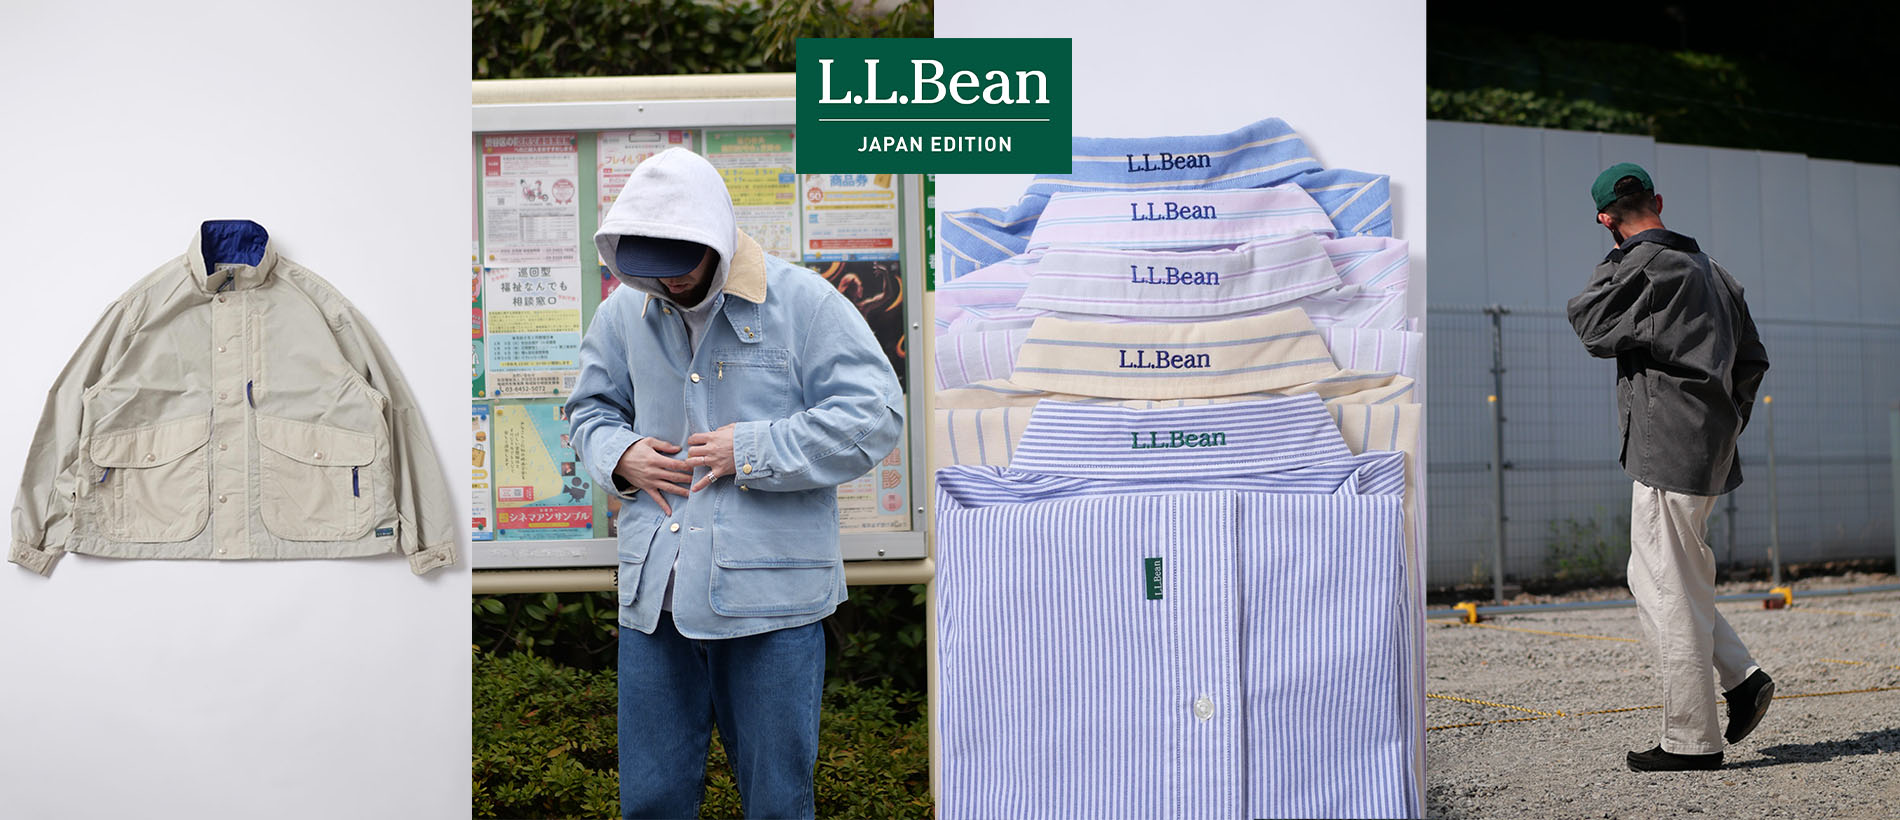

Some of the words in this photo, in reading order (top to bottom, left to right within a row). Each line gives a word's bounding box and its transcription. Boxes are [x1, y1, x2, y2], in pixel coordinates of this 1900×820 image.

[1126, 152, 1212, 173] L.L.Bean
[1130, 201, 1218, 222] L.L.Bean
[518, 266, 551, 278] 巡回型
[1130, 265, 1220, 286] L.L.Bean
[500, 281, 568, 293] 福祉なんでも
[512, 296, 557, 307] 相談窓口
[1119, 349, 1212, 369] L.L.Bean
[1131, 430, 1226, 449] L.L.Bean
[509, 511, 590, 523] シネマアンサンブル
[1153, 560, 1163, 596] L.L.Bean
